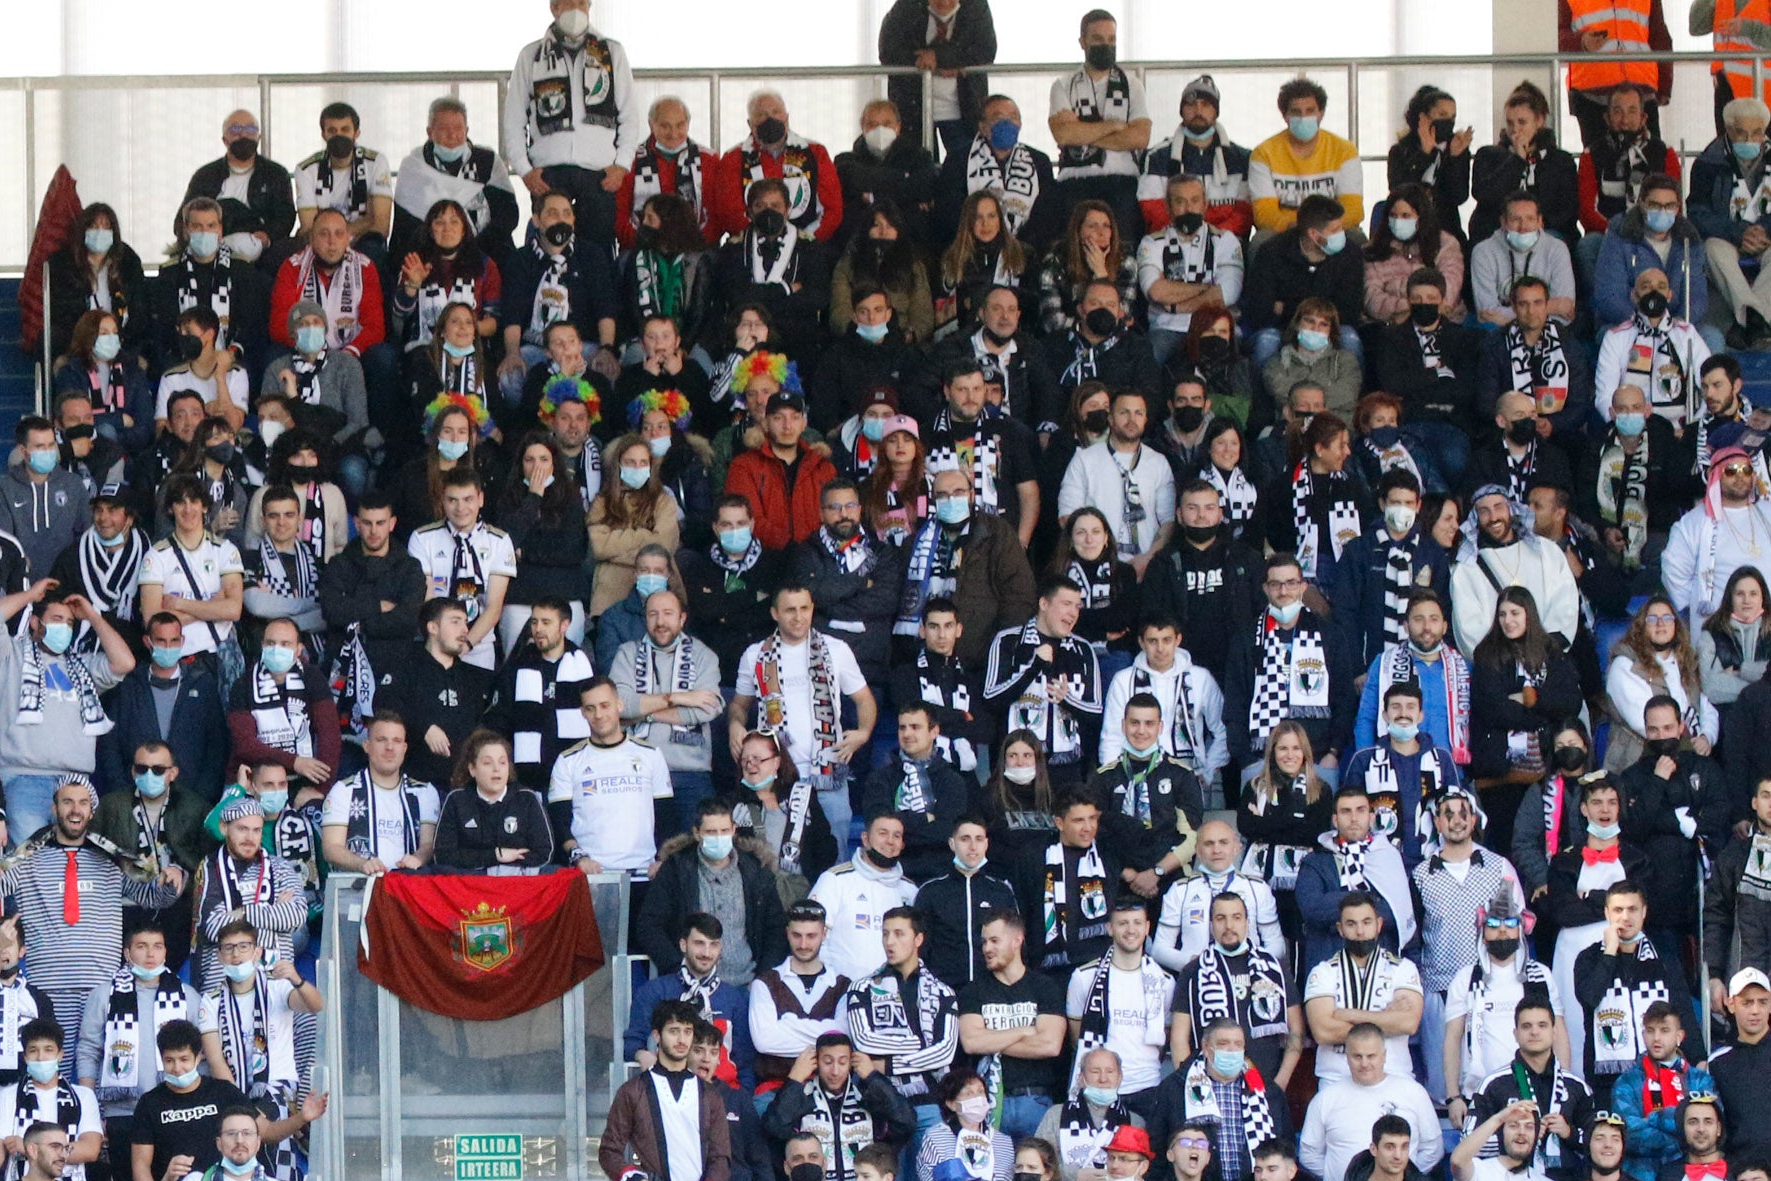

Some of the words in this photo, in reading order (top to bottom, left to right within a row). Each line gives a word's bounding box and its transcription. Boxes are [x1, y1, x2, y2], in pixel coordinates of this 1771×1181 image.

[600, 776, 643, 787] REALE
[161, 1103, 218, 1125] Kappa
[460, 1137, 518, 1154] SALIDA
[460, 1161, 518, 1178] IRTEERA
